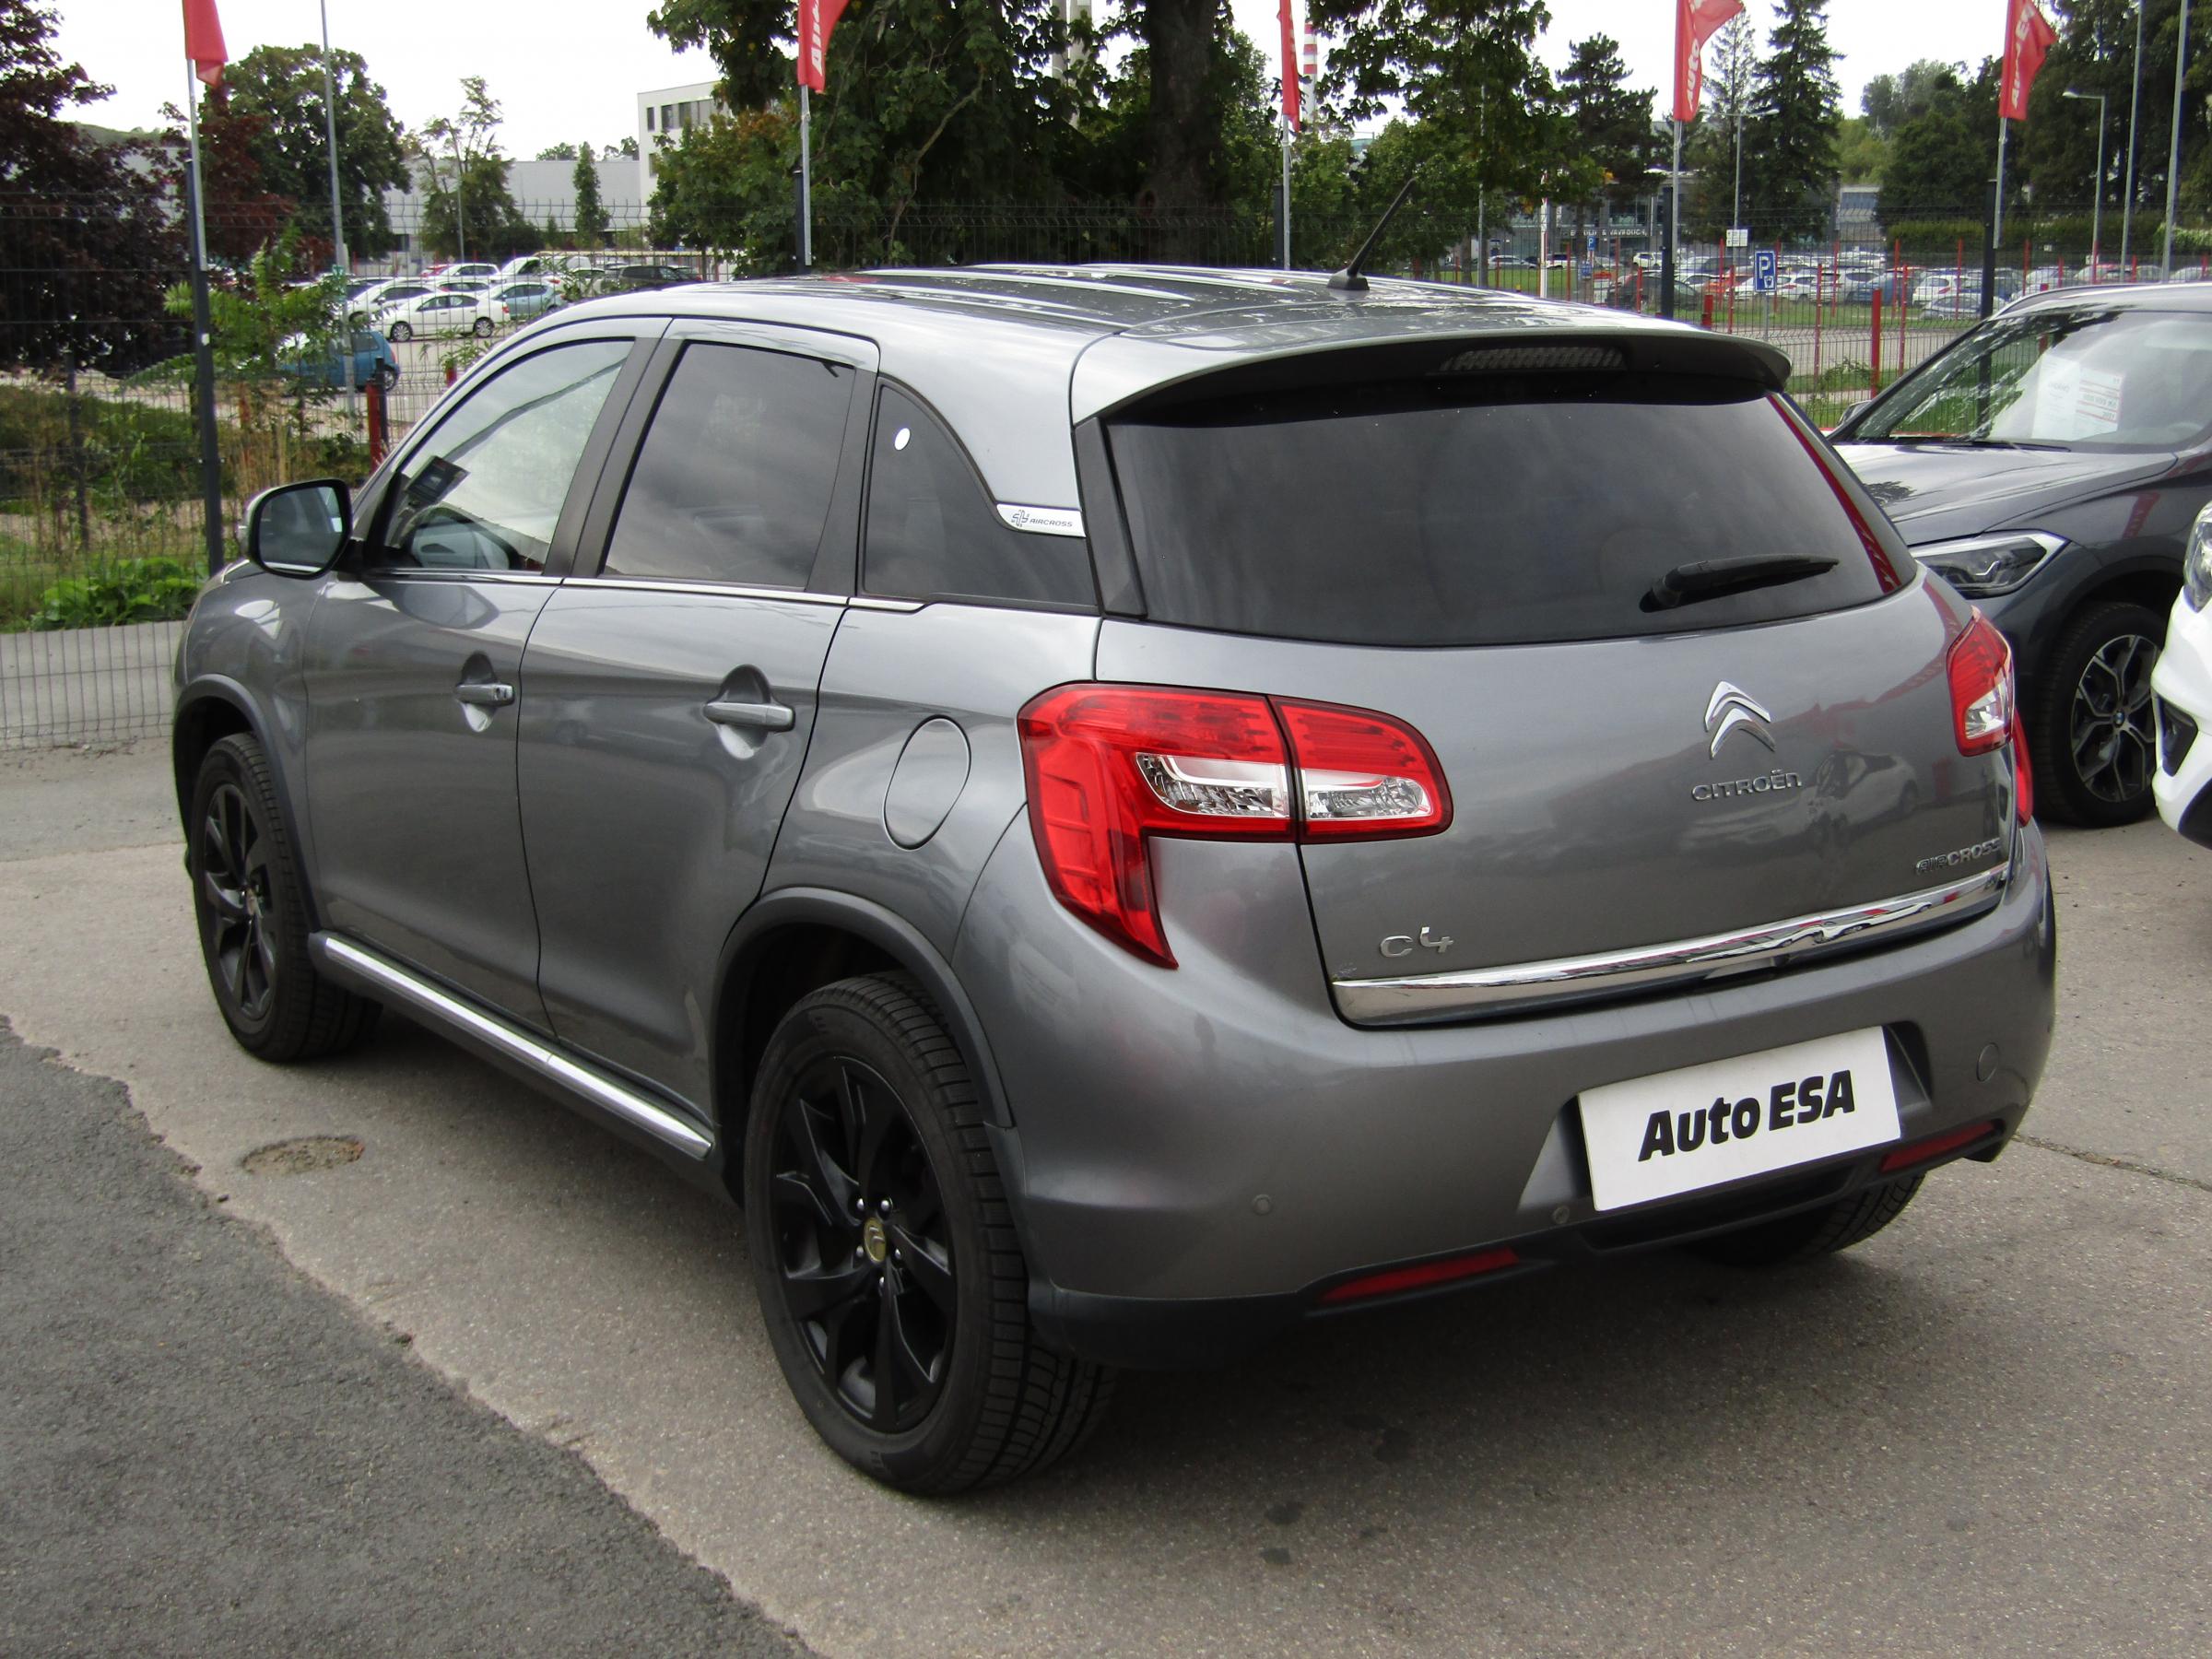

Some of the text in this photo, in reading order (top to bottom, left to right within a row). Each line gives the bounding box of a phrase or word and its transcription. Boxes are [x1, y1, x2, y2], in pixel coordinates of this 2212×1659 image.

[1759, 256, 1771, 279] P
[1030, 518, 1074, 528] AIRCROSS
[1381, 926, 1454, 958] C4
[1638, 1069, 1855, 1162] Auto ESA
